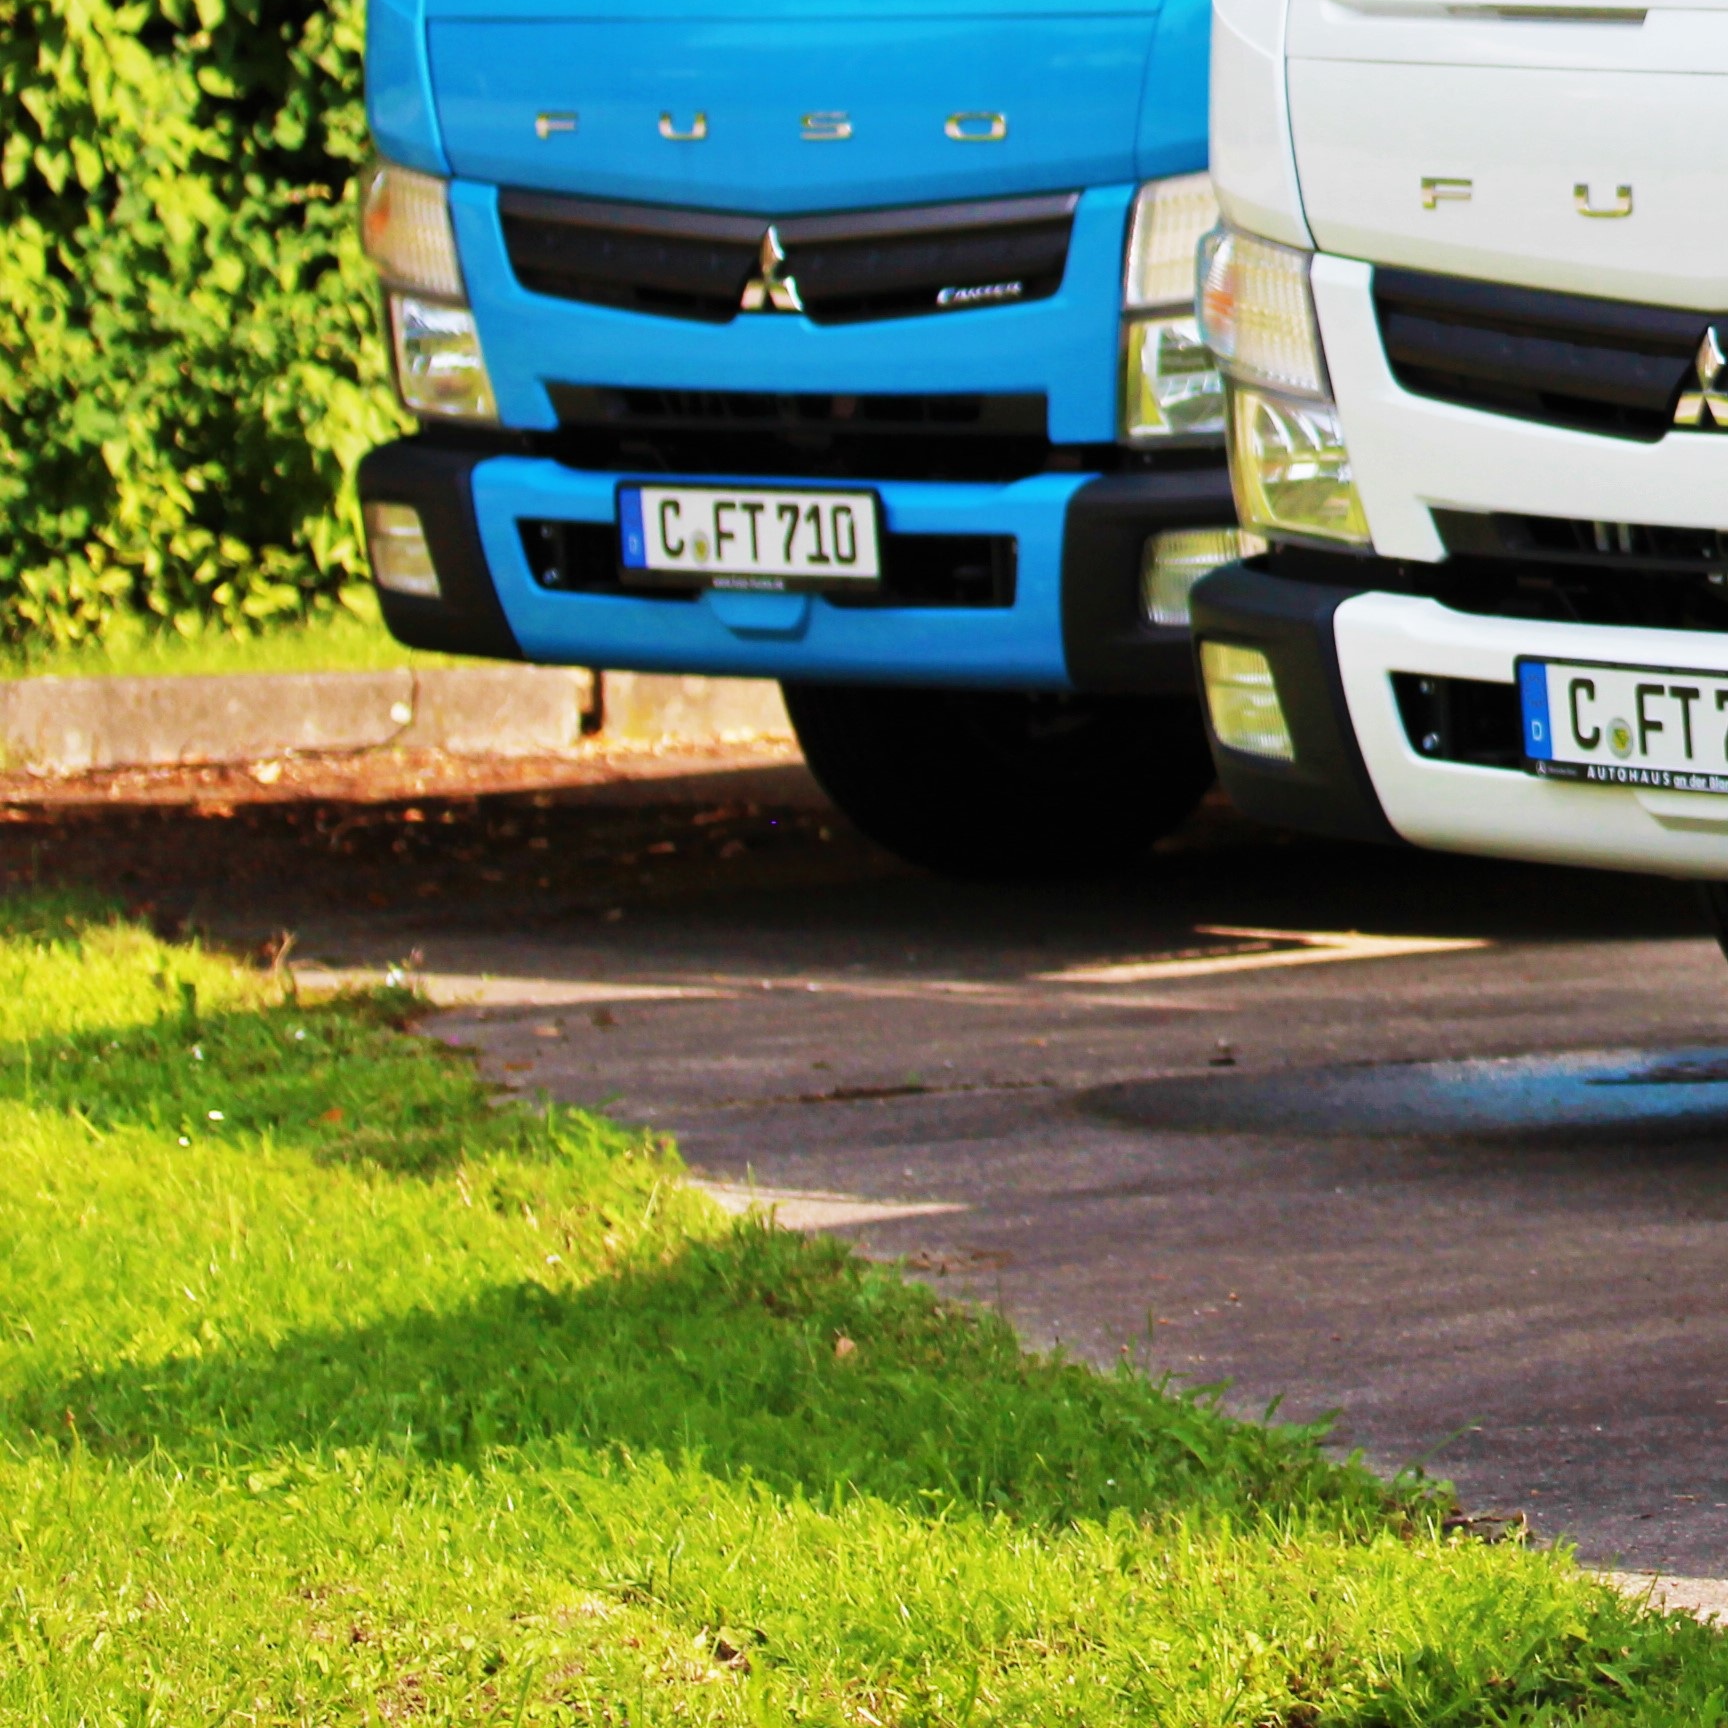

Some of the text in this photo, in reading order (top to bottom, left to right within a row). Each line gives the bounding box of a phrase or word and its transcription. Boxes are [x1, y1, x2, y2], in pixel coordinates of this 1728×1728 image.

[535, 111, 1008, 142] FUSO
[660, 499, 856, 564] C FT 710
[1531, 720, 1542, 741] D
[1569, 677, 1600, 751] C
[1636, 683, 1700, 759] FT
[1587, 765, 1670, 786] AUTOHAUS
[1673, 777, 1687, 788] an
[1689, 774, 1706, 790] der
